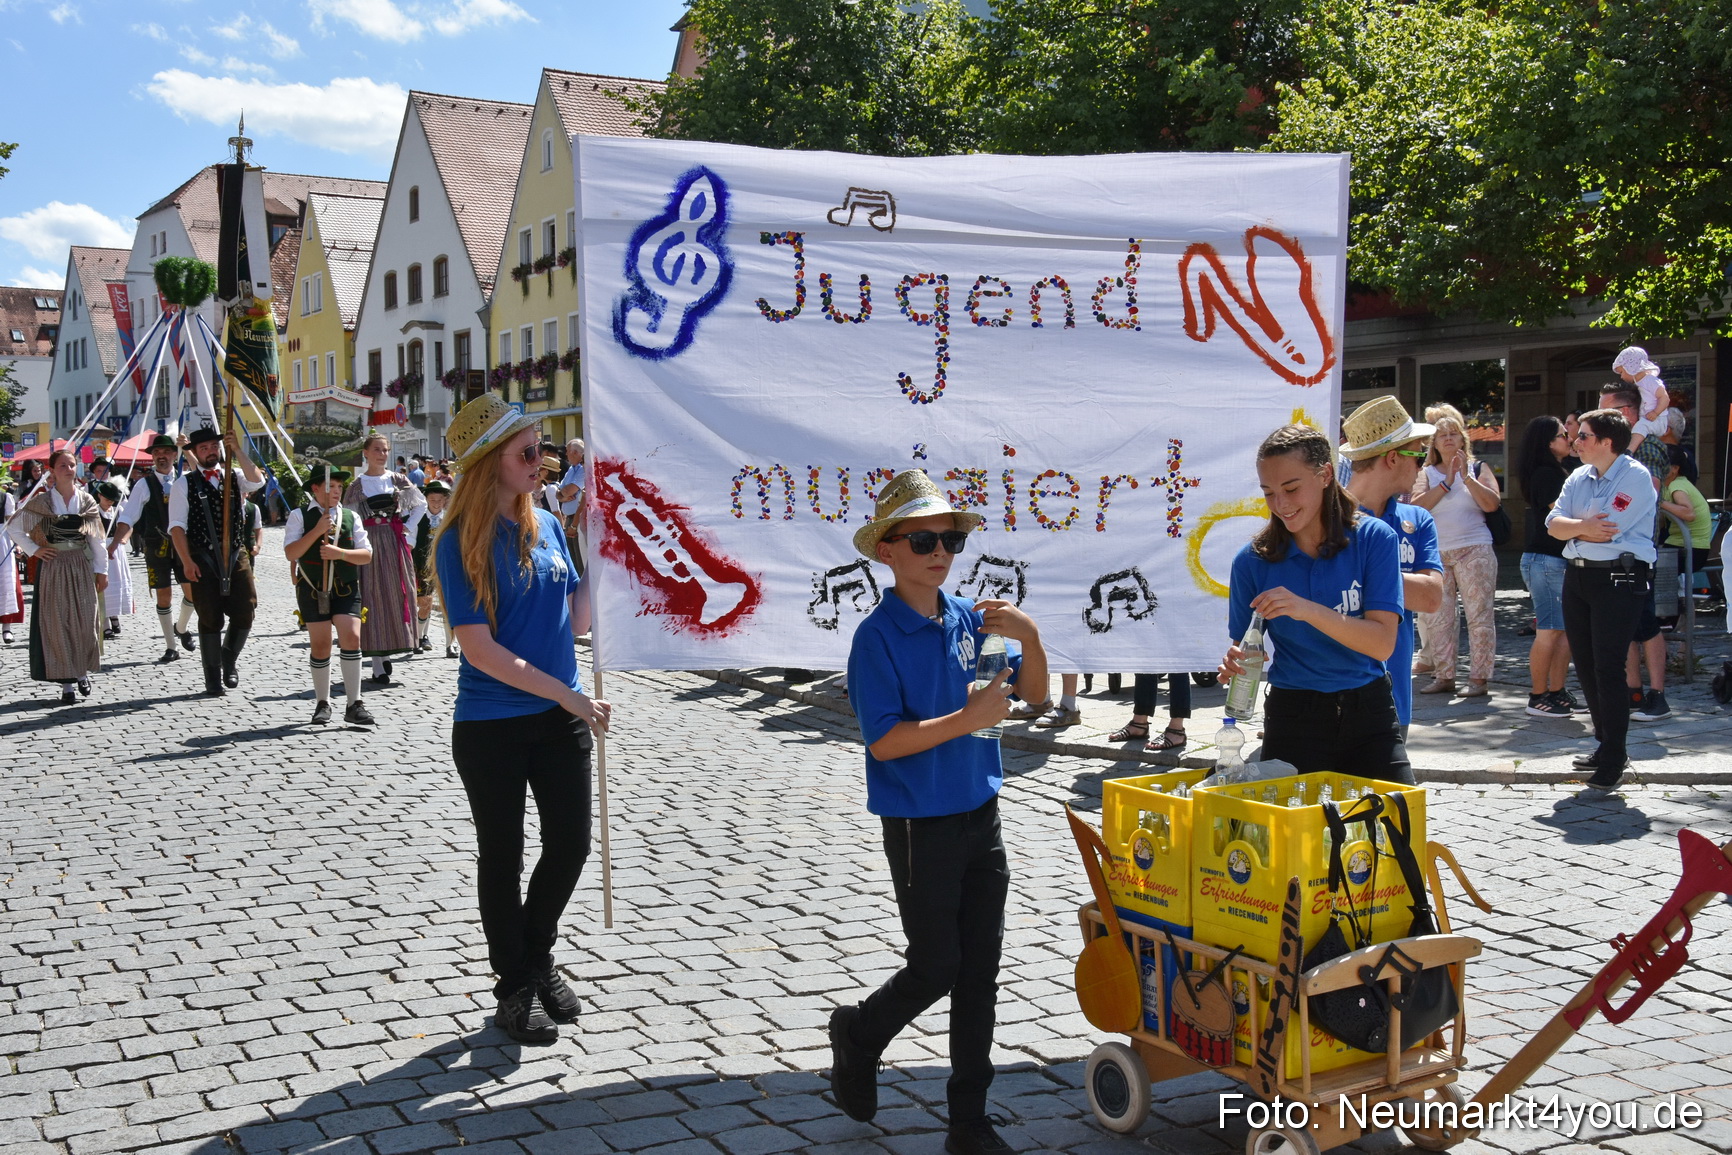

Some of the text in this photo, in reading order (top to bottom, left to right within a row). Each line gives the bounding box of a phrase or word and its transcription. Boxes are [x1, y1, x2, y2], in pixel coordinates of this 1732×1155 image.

[755, 231, 1142, 404] Jugend
[1109, 869, 1179, 898] Erfrischungen
[1200, 877, 1280, 914] Erfrischungen
[1133, 890, 1169, 908] RIEDENBURG
[1228, 905, 1269, 925] RIEDENBURG
